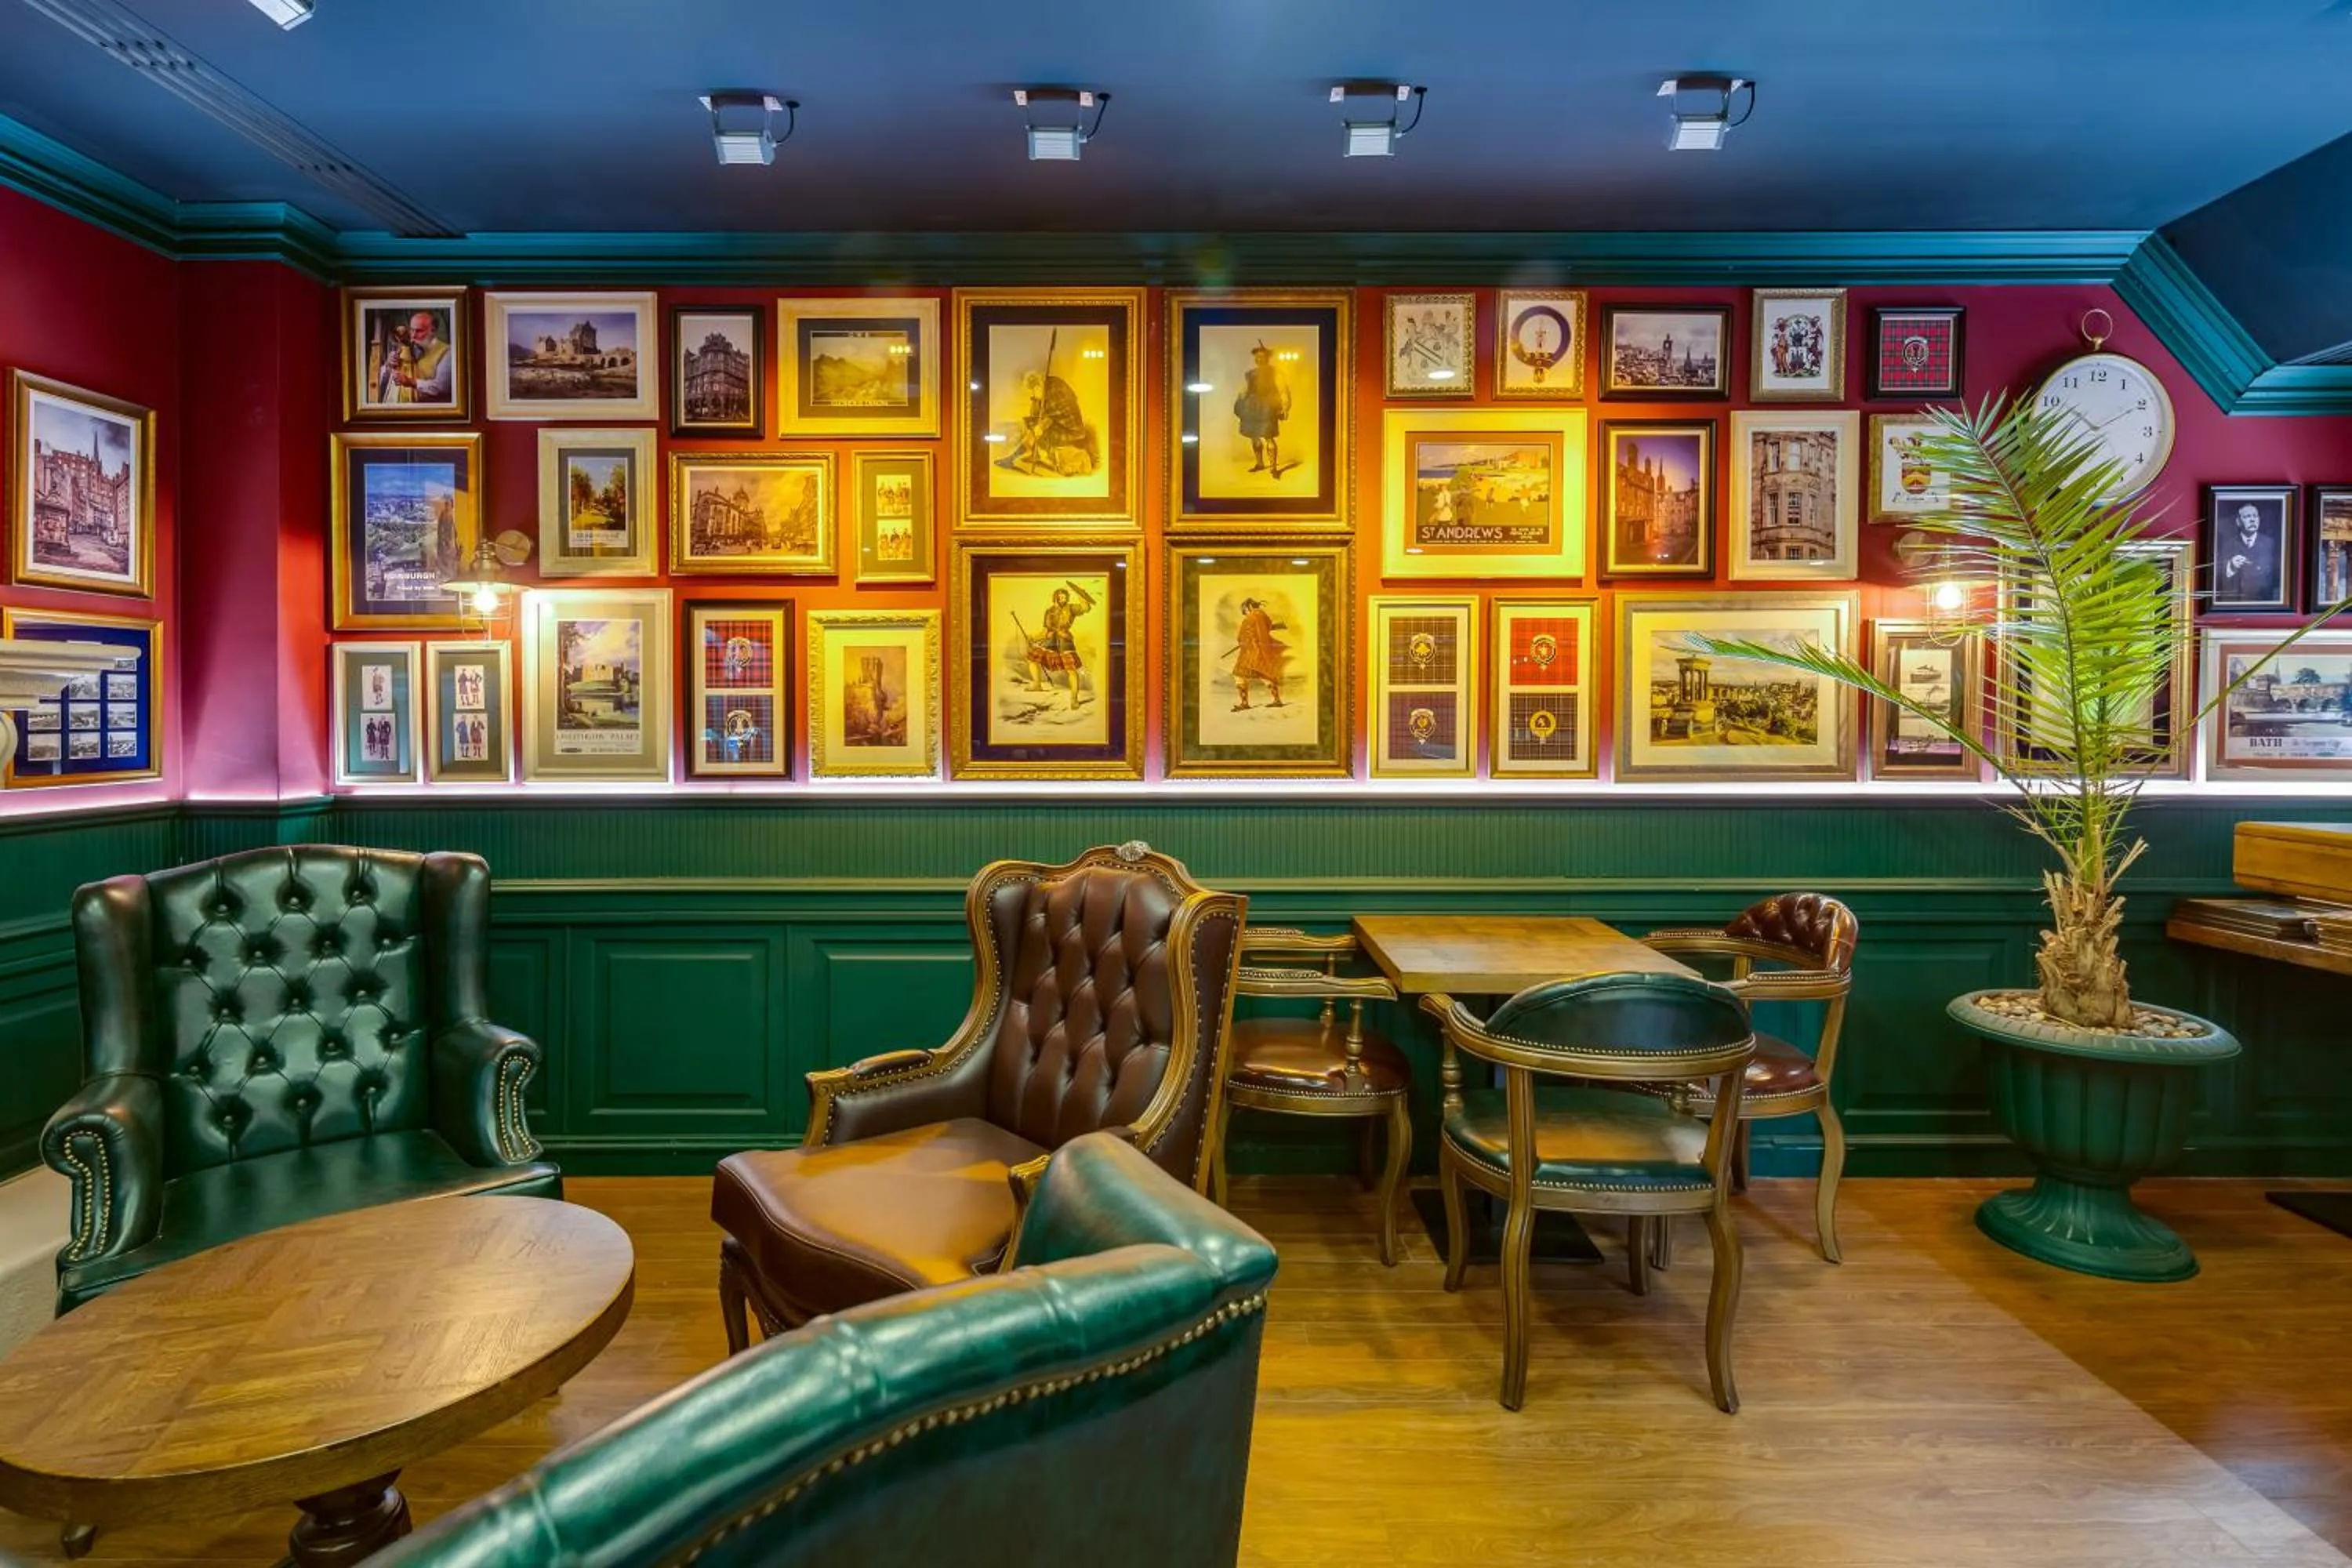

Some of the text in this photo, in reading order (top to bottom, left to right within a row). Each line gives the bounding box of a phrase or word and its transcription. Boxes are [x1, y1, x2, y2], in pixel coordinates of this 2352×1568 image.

[2090, 370, 2107, 382] 12
[2063, 376, 2078, 389] 11
[2121, 379, 2126, 390] 1
[2043, 396, 2060, 407] 10
[2137, 399, 2147, 410] 2
[2143, 426, 2152, 437] 3
[2135, 452, 2144, 463] 4
[1436, 527, 1503, 539] ANDREWS
[2249, 739, 2282, 747] BATH
